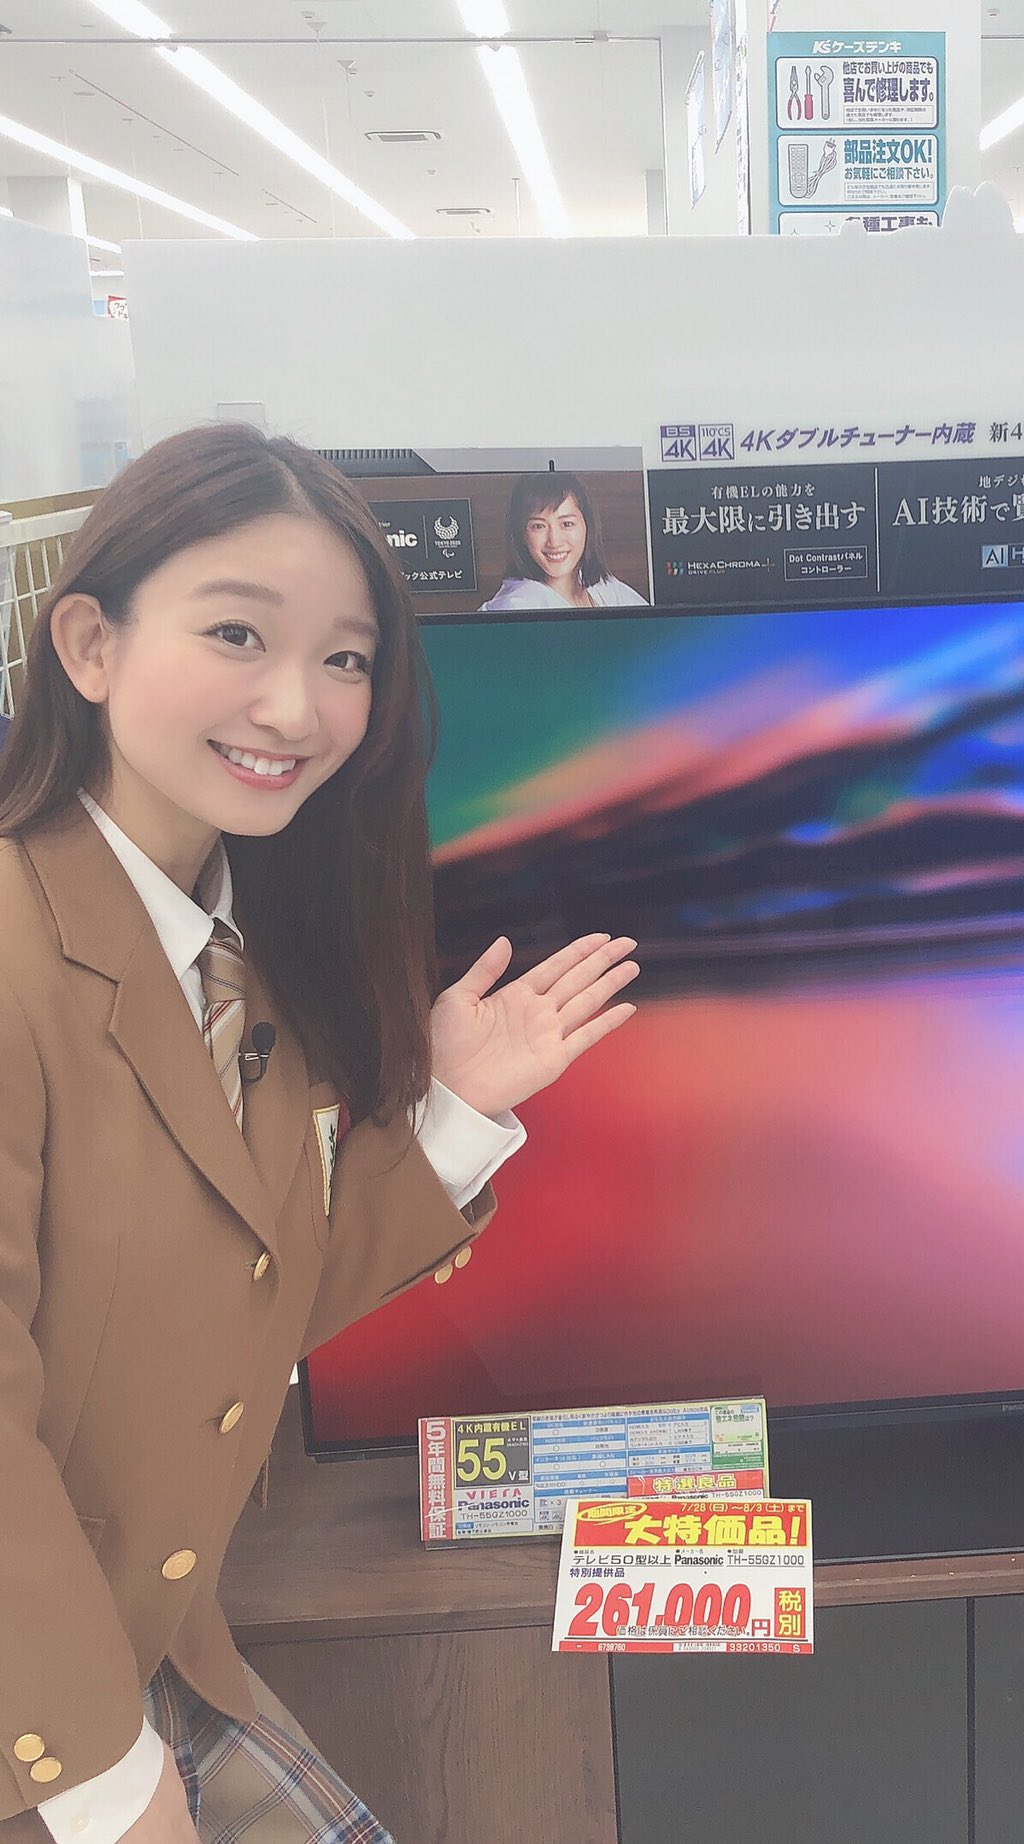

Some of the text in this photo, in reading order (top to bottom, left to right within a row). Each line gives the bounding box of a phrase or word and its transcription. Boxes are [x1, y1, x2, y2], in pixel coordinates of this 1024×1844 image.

[842, 61, 934, 75] 他店でお買い上げの商品でも
[842, 77, 934, 103] 喜んで修理します。
[844, 167, 934, 180] お気軽にご相談下さい。
[666, 427, 691, 437] BS
[740, 422, 976, 452] 4Kダブルチューナー内蔵
[664, 439, 696, 460] 4K
[702, 438, 734, 459] 4K
[711, 482, 816, 500] 有機ELの能力を
[662, 500, 866, 536] 最大限に引き出す
[789, 554, 804, 563] Dot
[985, 547, 1004, 565] AI
[801, 564, 852, 575] コントローラー
[457, 1437, 507, 1482] 55
[426, 1420, 448, 1539] 5年間無料保証
[653, 1473, 737, 1493] 特選良品
[458, 1498, 530, 1511] Panasonic
[587, 1505, 638, 1520] 期間限定
[572, 1554, 805, 1565] テレビ50型以上 Panasonic TH-55GZ1000
[569, 1567, 625, 1578] 特別提供品
[778, 1590, 802, 1635] 税別
[729, 1643, 781, 1652] 33201350
[792, 1644, 801, 1652] S
